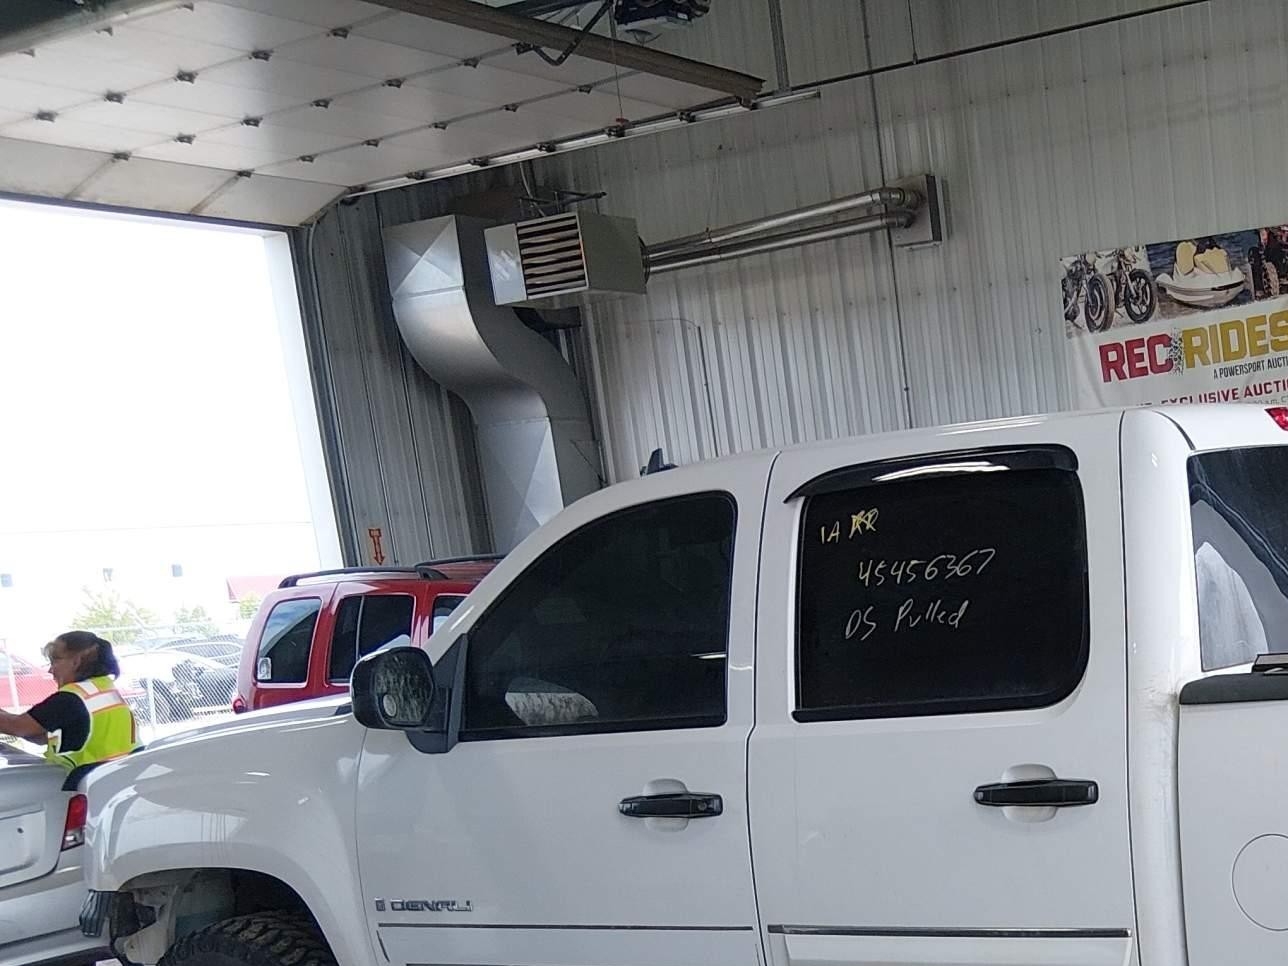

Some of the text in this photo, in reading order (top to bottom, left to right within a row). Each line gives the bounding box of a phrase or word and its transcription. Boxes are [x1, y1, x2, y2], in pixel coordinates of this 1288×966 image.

[1099, 333, 1174, 382] REC
[1213, 368, 1219, 379] A
[1219, 361, 1265, 378] POWERSPORT
[858, 548, 996, 587] 45456367
[894, 598, 969, 632] Pulled
[390, 899, 473, 912] DENALI
